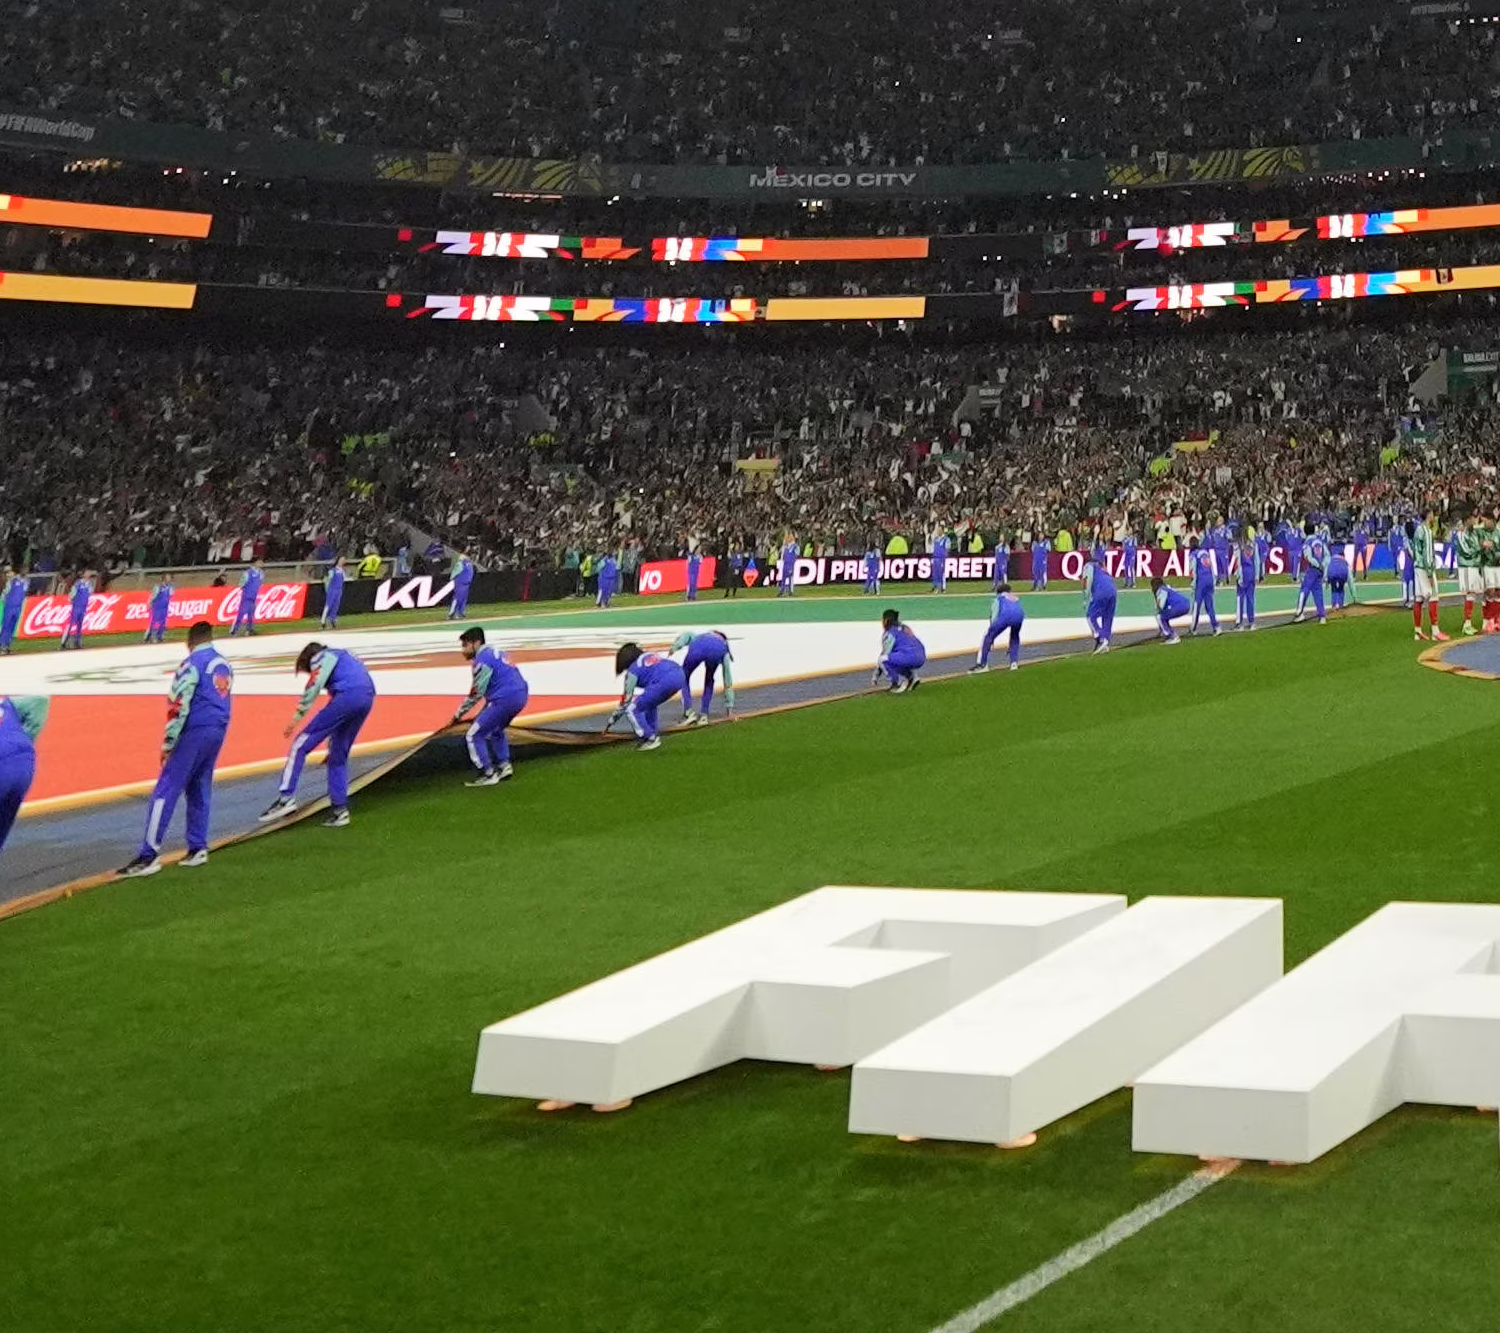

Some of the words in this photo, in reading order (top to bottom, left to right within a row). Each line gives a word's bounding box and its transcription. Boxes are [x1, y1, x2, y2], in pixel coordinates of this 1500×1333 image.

[749, 171, 851, 188] MEXICO
[856, 172, 916, 187] CITY
[830, 557, 995, 582] PREICTSREET
[1061, 548, 1152, 580] QTAR
[168, 599, 213, 621] sugar
[217, 585, 303, 622] CoCola
